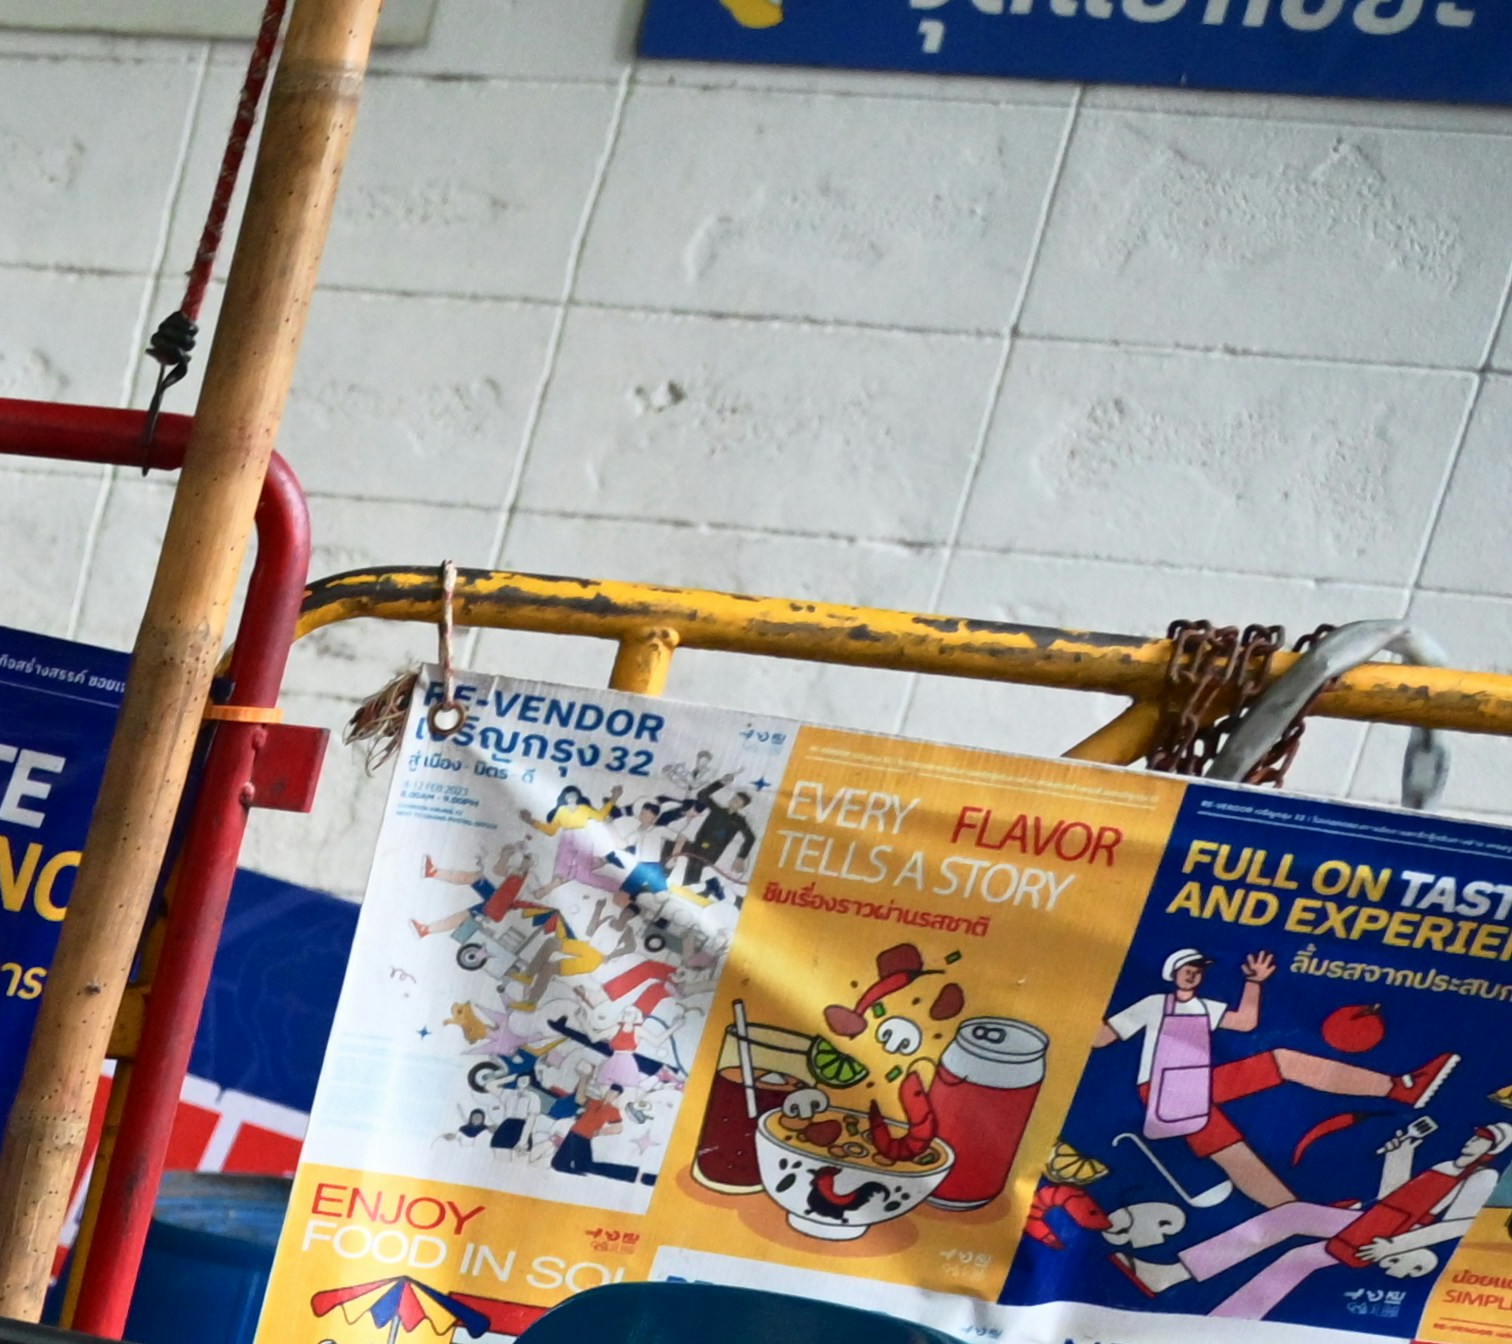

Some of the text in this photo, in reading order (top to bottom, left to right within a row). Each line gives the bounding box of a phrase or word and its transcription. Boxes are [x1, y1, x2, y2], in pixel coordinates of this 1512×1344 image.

[423, 682, 665, 743] RE-VENDOR
[416, 716, 655, 778] เริญกรุง 32
[786, 780, 1122, 868] EVERY FLAVOR
[777, 830, 1078, 912] TELLS A STORY
[1182, 840, 1512, 917] FULL ON TAST
[1166, 881, 1512, 962] AND EXPERIE
[311, 1182, 486, 1236] ENJOY
[302, 1220, 447, 1270] FOOD
[460, 1243, 514, 1283] IN
[1443, 1289, 1512, 1311] SIMPL
